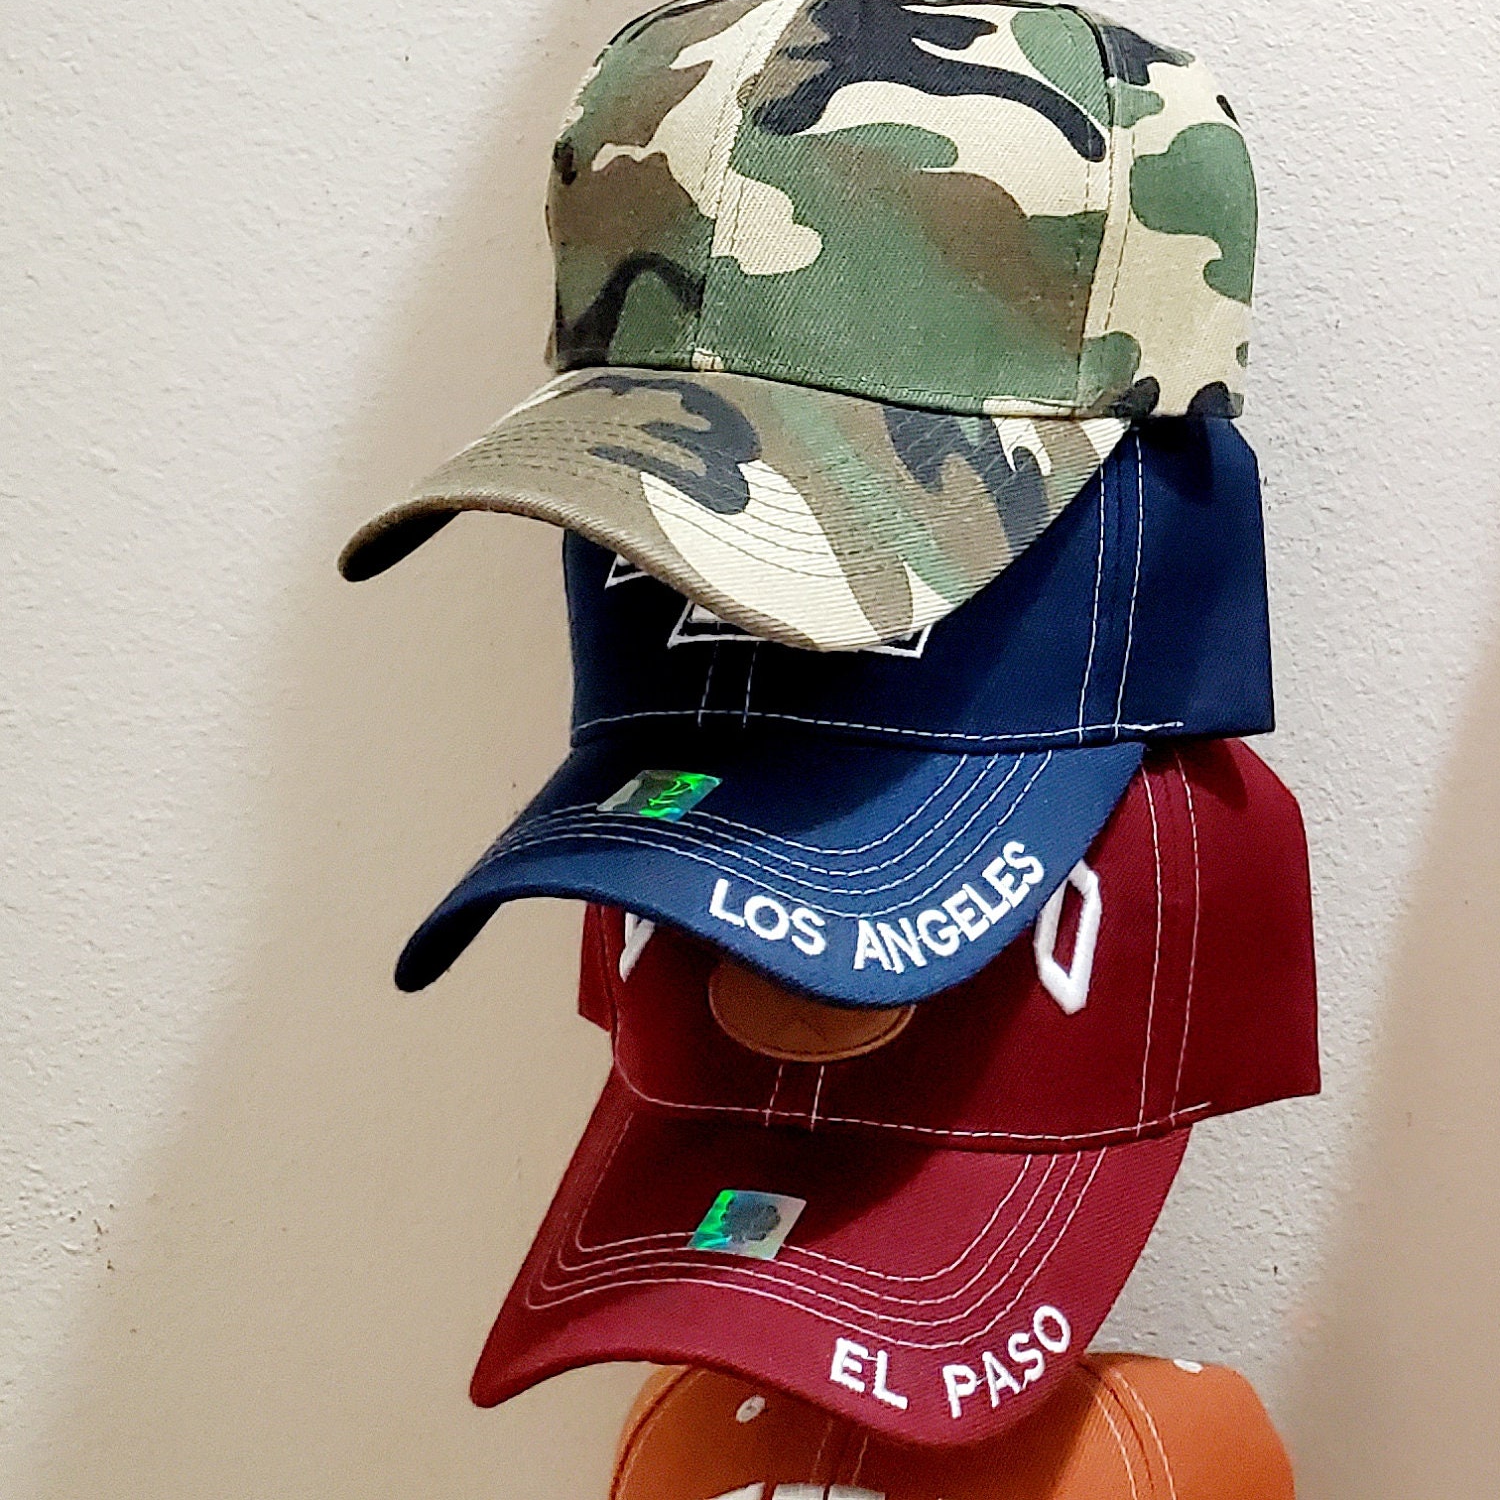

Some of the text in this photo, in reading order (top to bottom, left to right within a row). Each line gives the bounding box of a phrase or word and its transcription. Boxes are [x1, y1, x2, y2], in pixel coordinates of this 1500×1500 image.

[709, 841, 1045, 974] LOS ANGELES
[830, 1305, 1071, 1419] EL PASO
